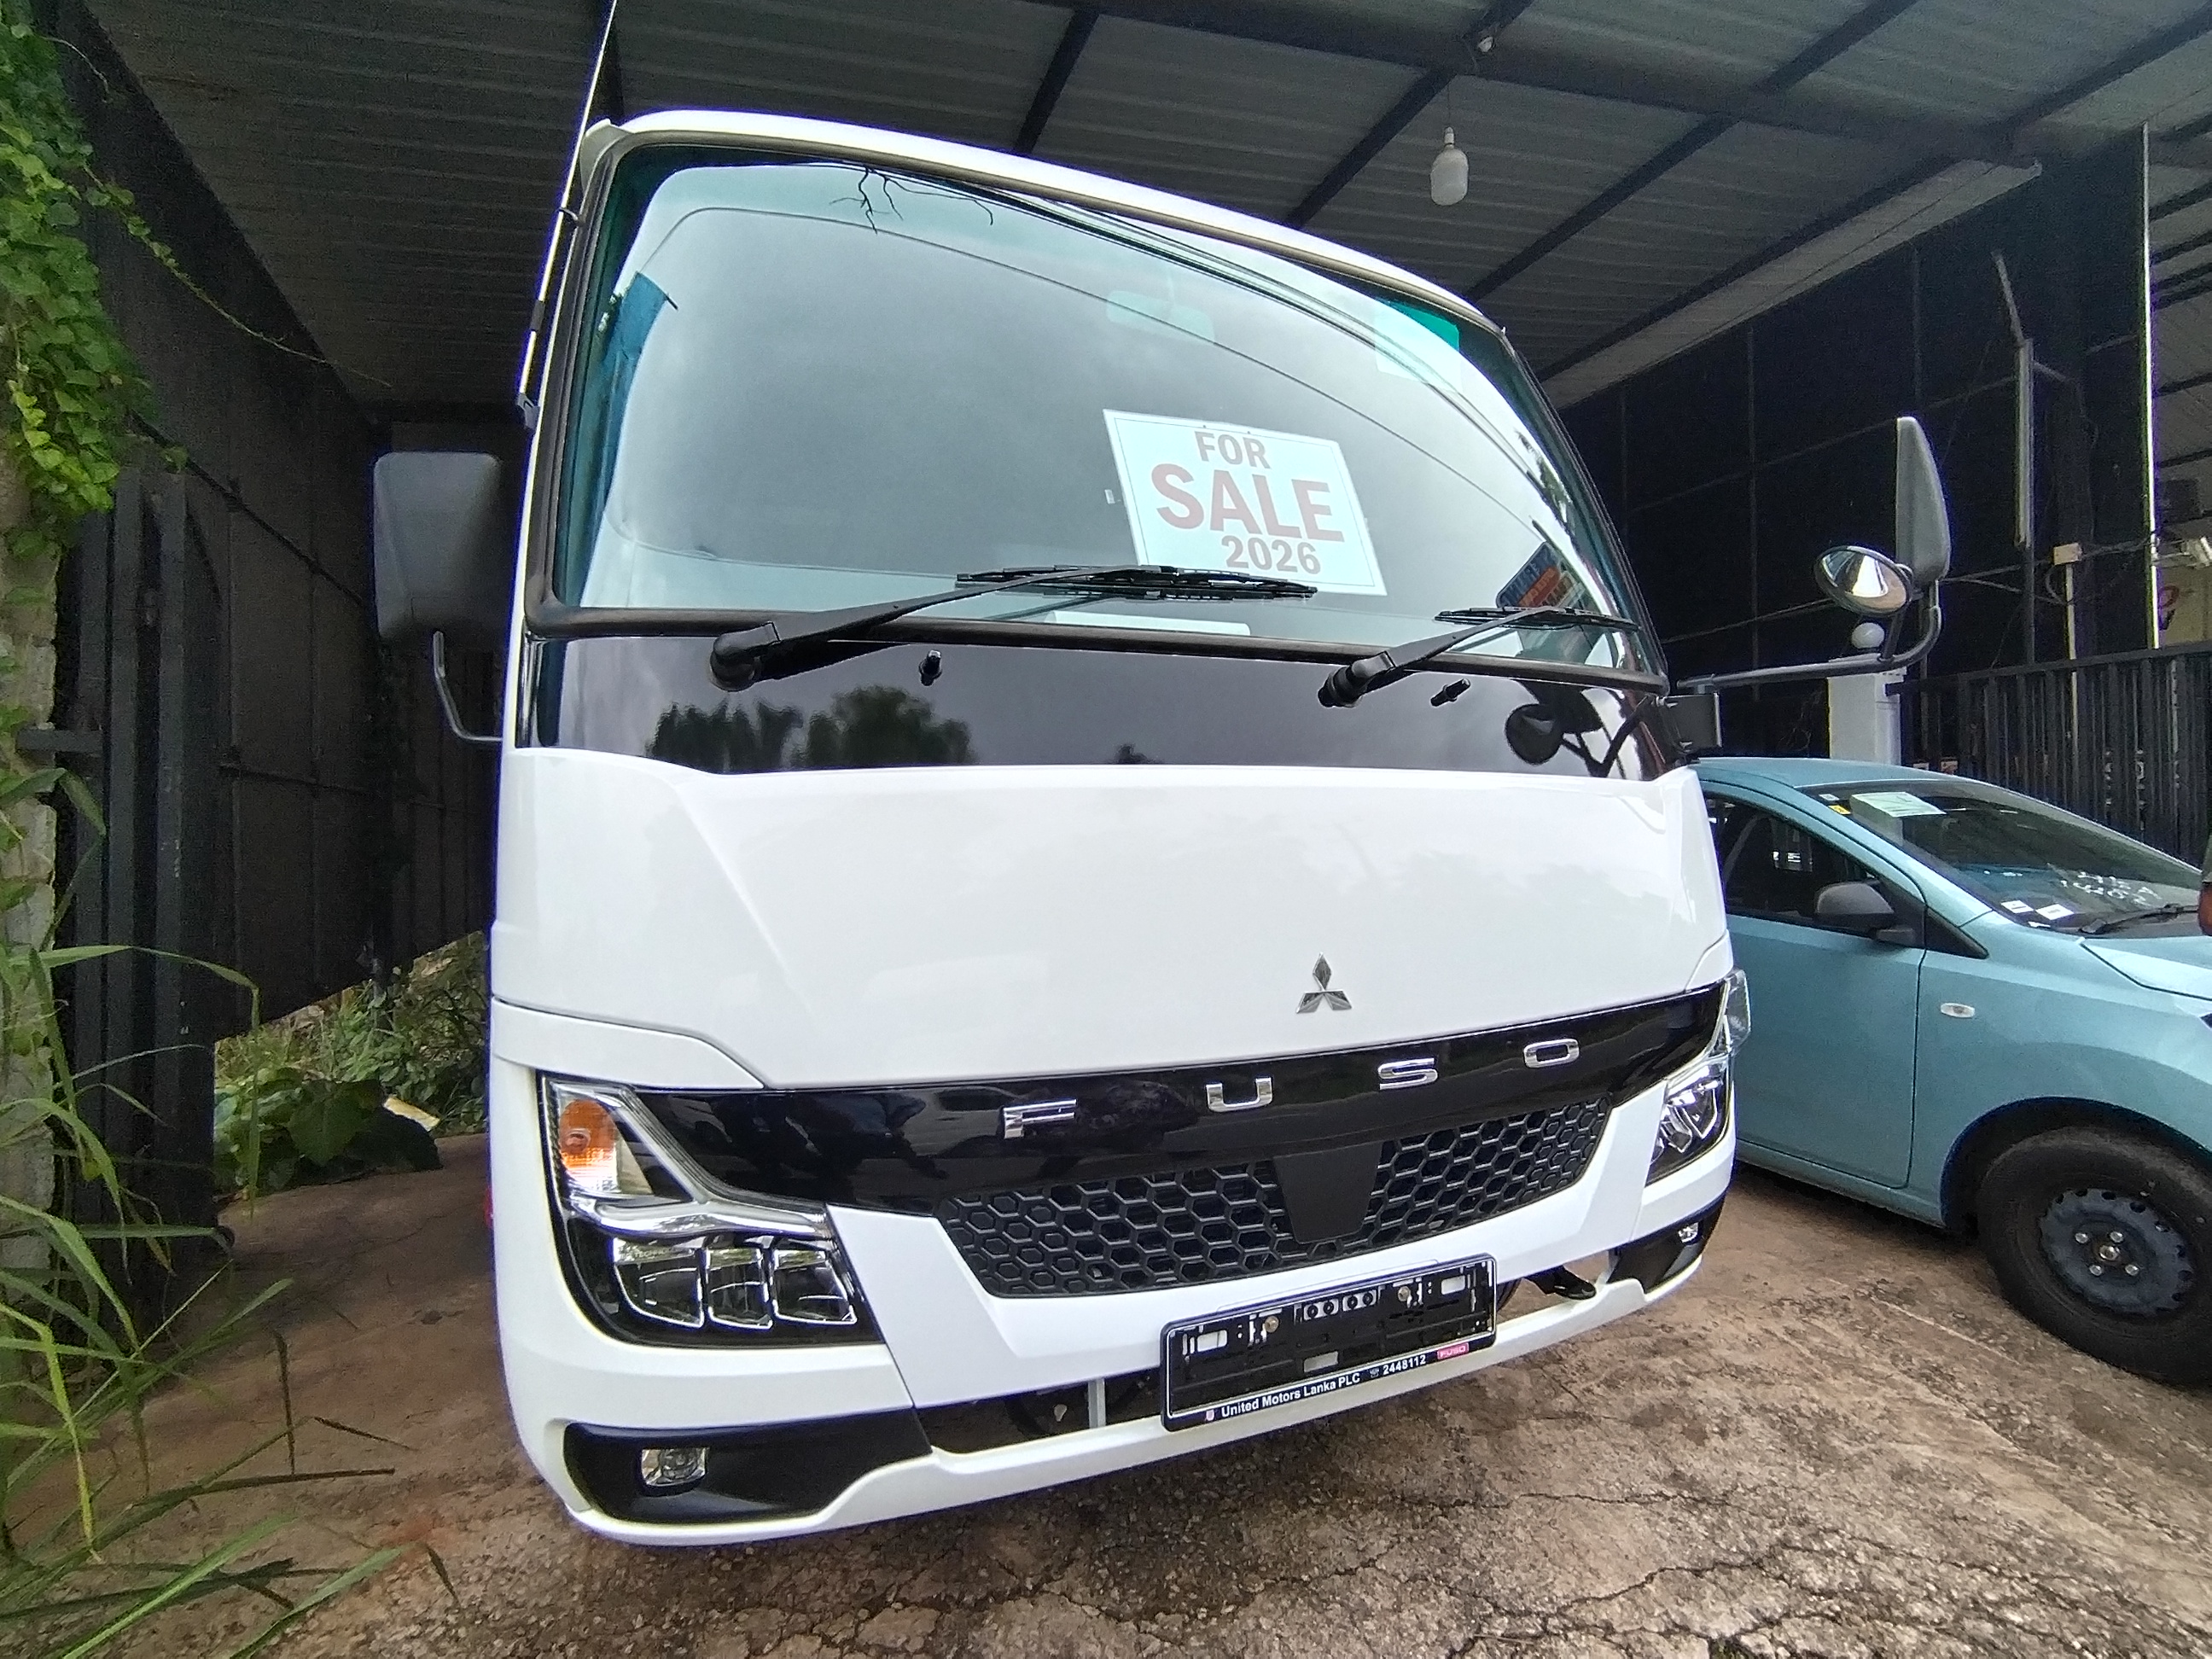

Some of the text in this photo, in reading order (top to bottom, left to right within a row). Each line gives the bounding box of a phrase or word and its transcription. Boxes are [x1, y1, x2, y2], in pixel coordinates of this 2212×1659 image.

[1195, 430, 1272, 469] FOR
[1150, 463, 1345, 543] SALE
[1221, 534, 1322, 574] 2026
[1003, 1038, 1580, 1140] FUSO
[1439, 1345, 1466, 1358] FUSO
[1221, 1353, 1427, 1417] United Motors Lanka PLC 2448112
